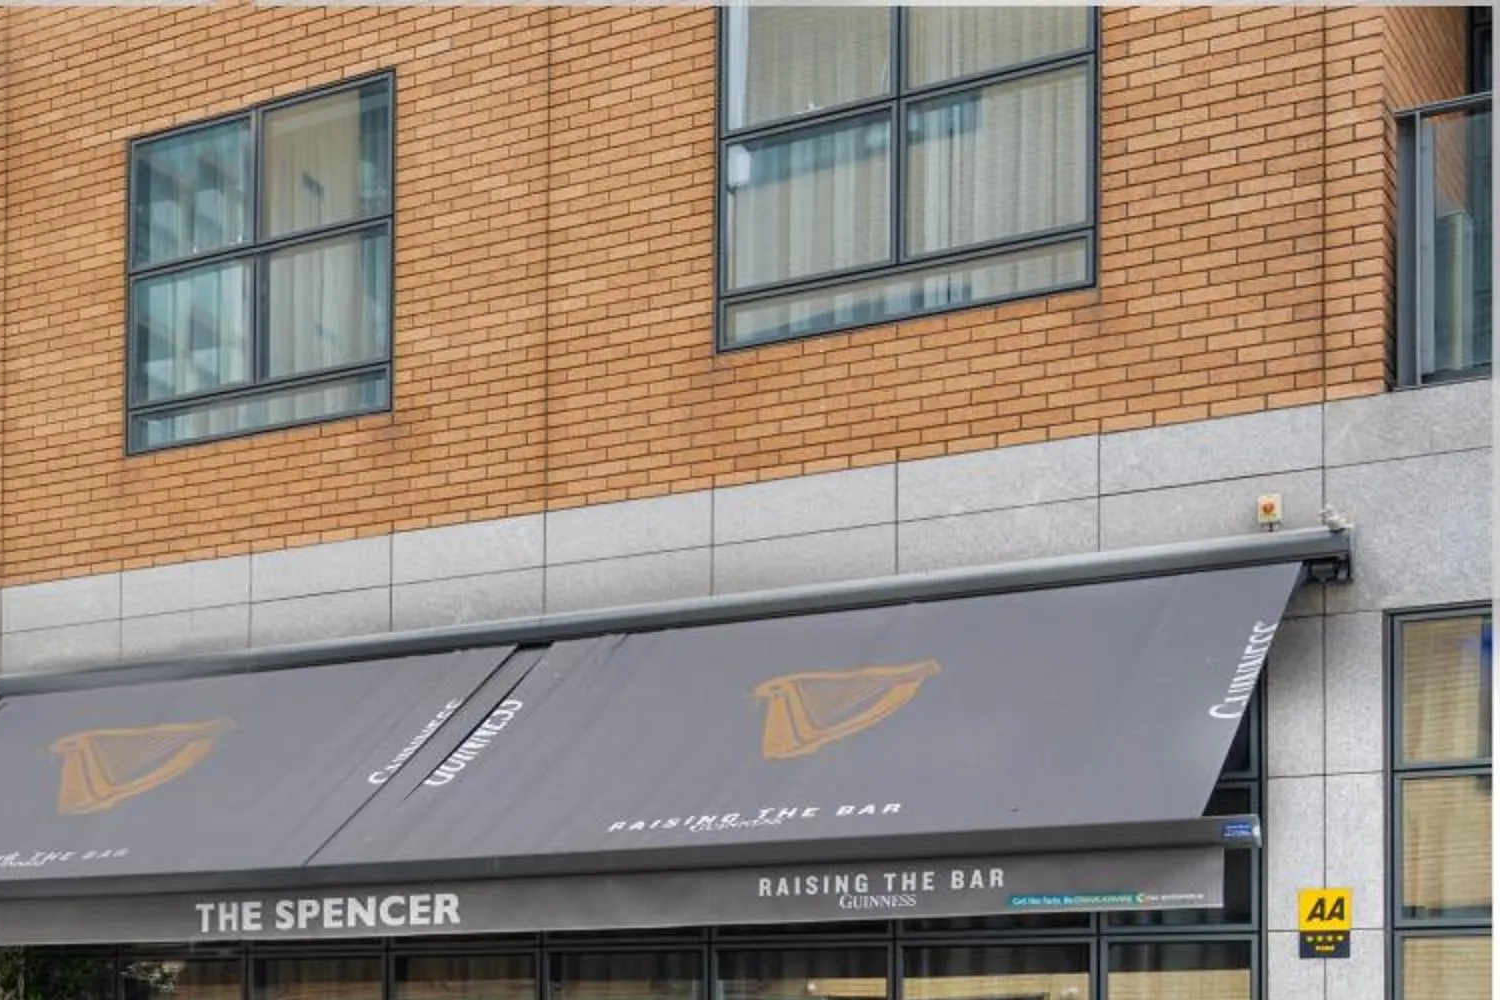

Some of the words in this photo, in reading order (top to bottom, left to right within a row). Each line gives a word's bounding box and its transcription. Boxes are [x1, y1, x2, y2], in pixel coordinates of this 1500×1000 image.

[758, 806, 820, 820] THE
[836, 803, 901, 816] BAR
[758, 873, 869, 897] RAISING
[883, 871, 935, 892] THE
[950, 867, 1005, 890] BAR
[196, 901, 263, 933] THE
[275, 893, 461, 930] SPENCER
[839, 893, 917, 909] GUINNESS
[1306, 897, 1345, 921] AA
